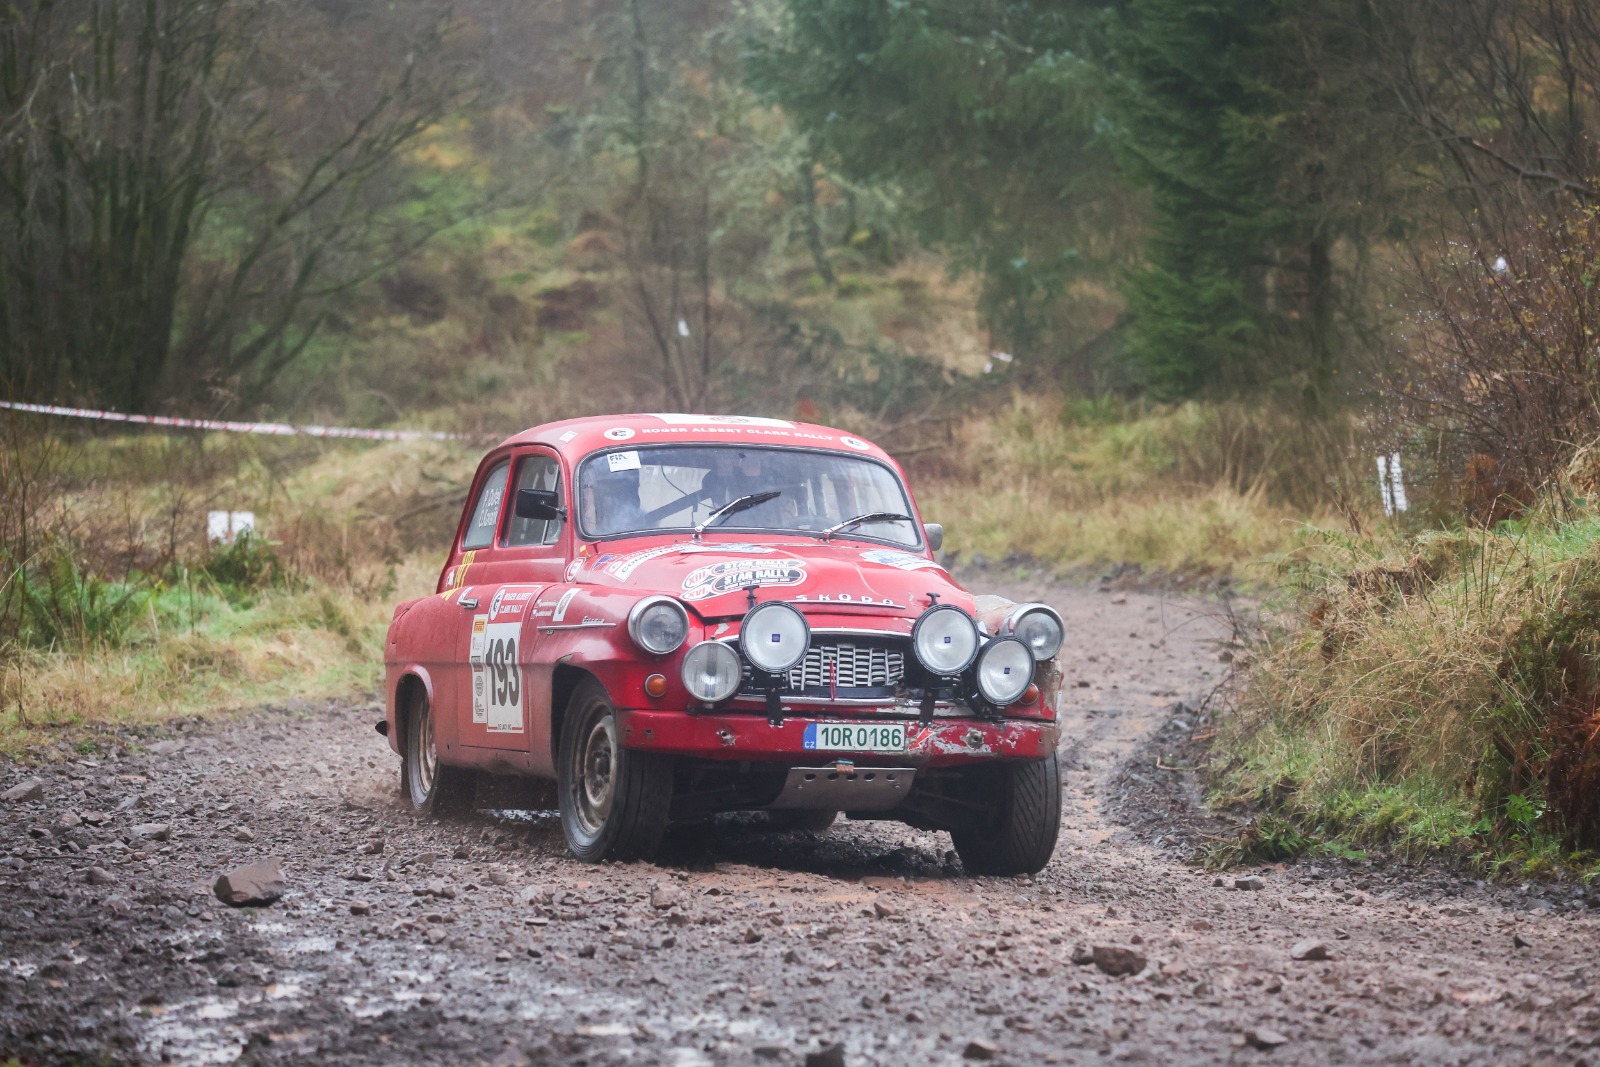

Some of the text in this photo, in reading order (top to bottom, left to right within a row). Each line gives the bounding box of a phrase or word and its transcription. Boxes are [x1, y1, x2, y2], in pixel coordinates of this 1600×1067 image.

[746, 429, 791, 437] CLARK
[793, 432, 833, 441] RALLY
[724, 571, 753, 586] STAR
[756, 569, 790, 581] RALLY
[486, 637, 520, 707] 193
[804, 741, 815, 749] CZ
[821, 727, 902, 747] 10R 0186
